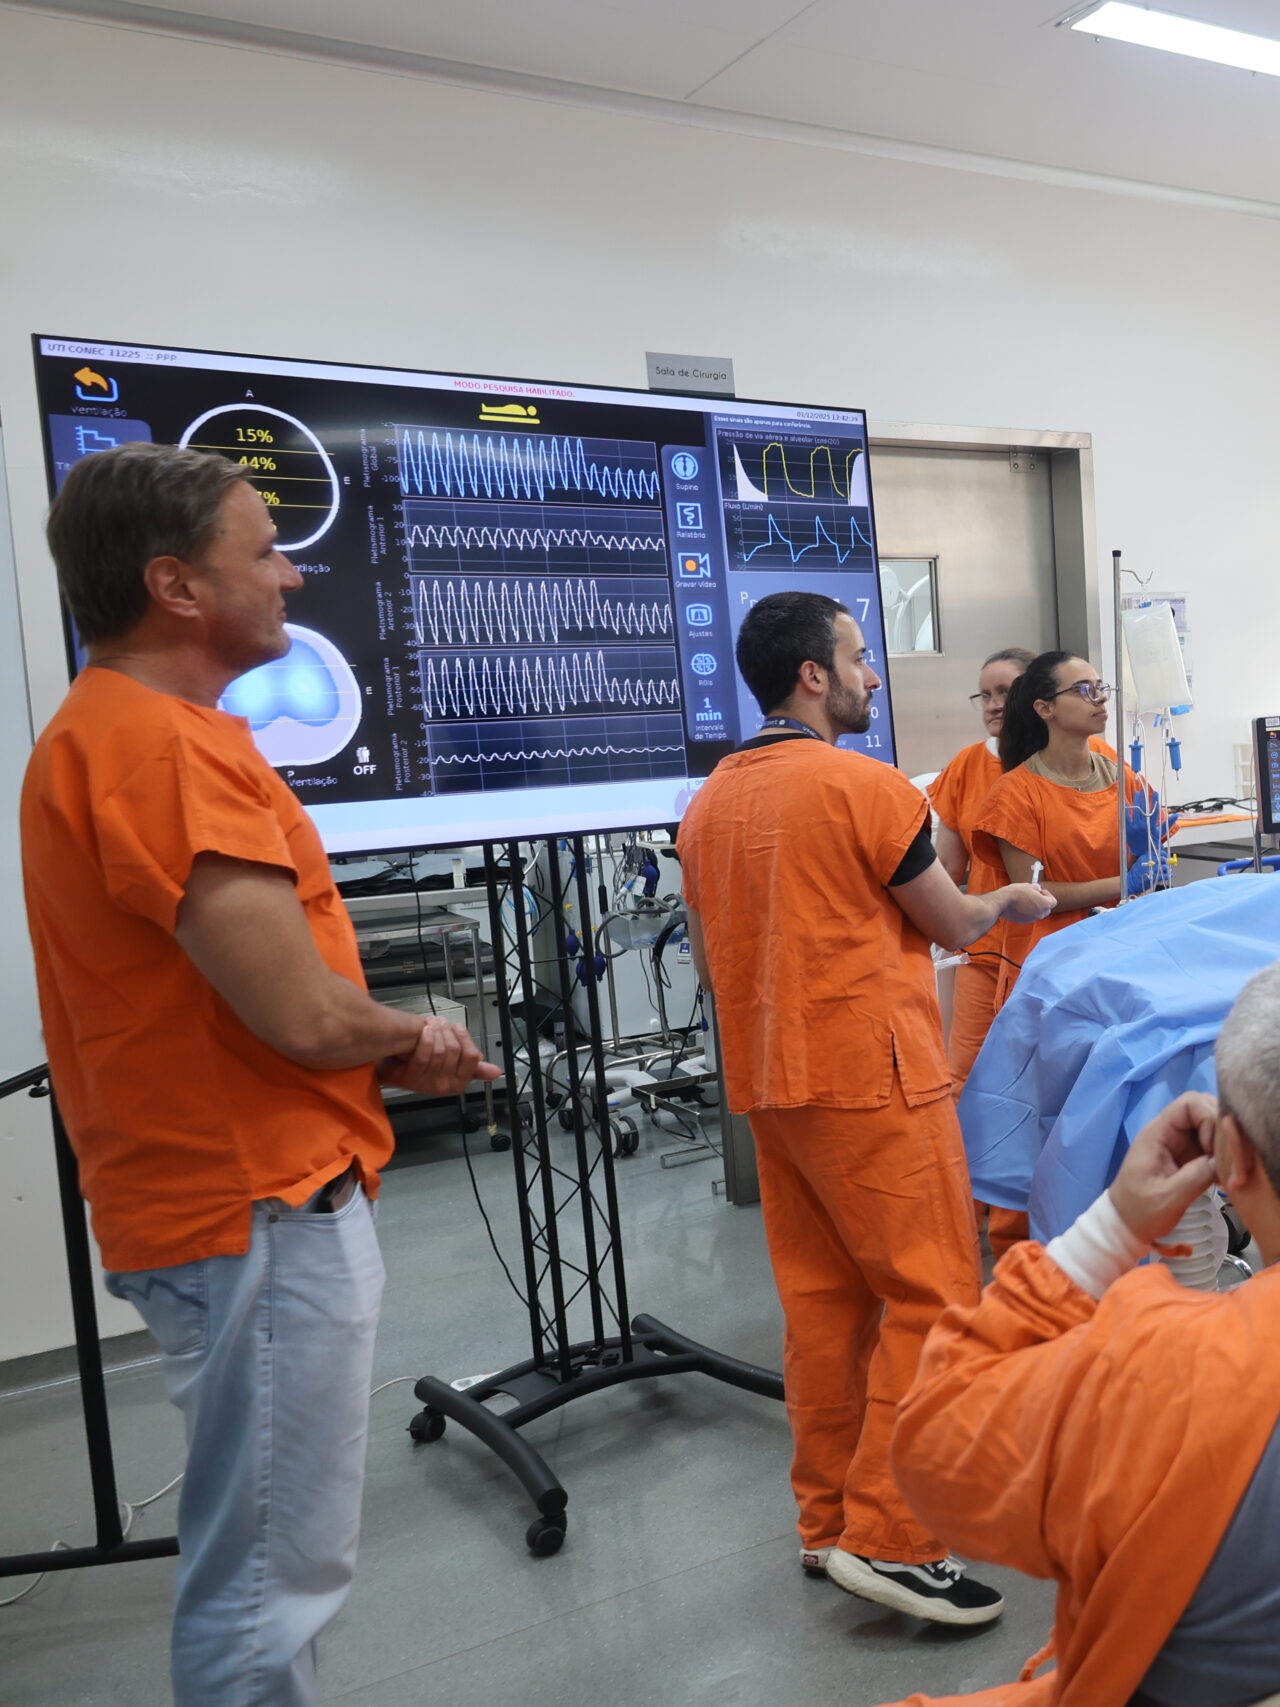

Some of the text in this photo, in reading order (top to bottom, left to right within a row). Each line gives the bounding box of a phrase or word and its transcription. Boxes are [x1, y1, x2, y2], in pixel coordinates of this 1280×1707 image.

[68, 345, 104, 356] CONEC
[109, 348, 140, 359] 11225
[156, 352, 177, 361] PPP
[655, 366, 727, 380] Sala de Cirurgia
[245, 390, 254, 398] A
[454, 380, 481, 390] MODO
[483, 383, 524, 394] PESQUISA
[236, 428, 274, 443] 15%
[238, 456, 276, 470] 44%
[370, 446, 378, 471] Global
[704, 698, 712, 708] 1
[696, 710, 722, 721] min
[866, 736, 882, 748] 11
[353, 764, 376, 776] OFF
